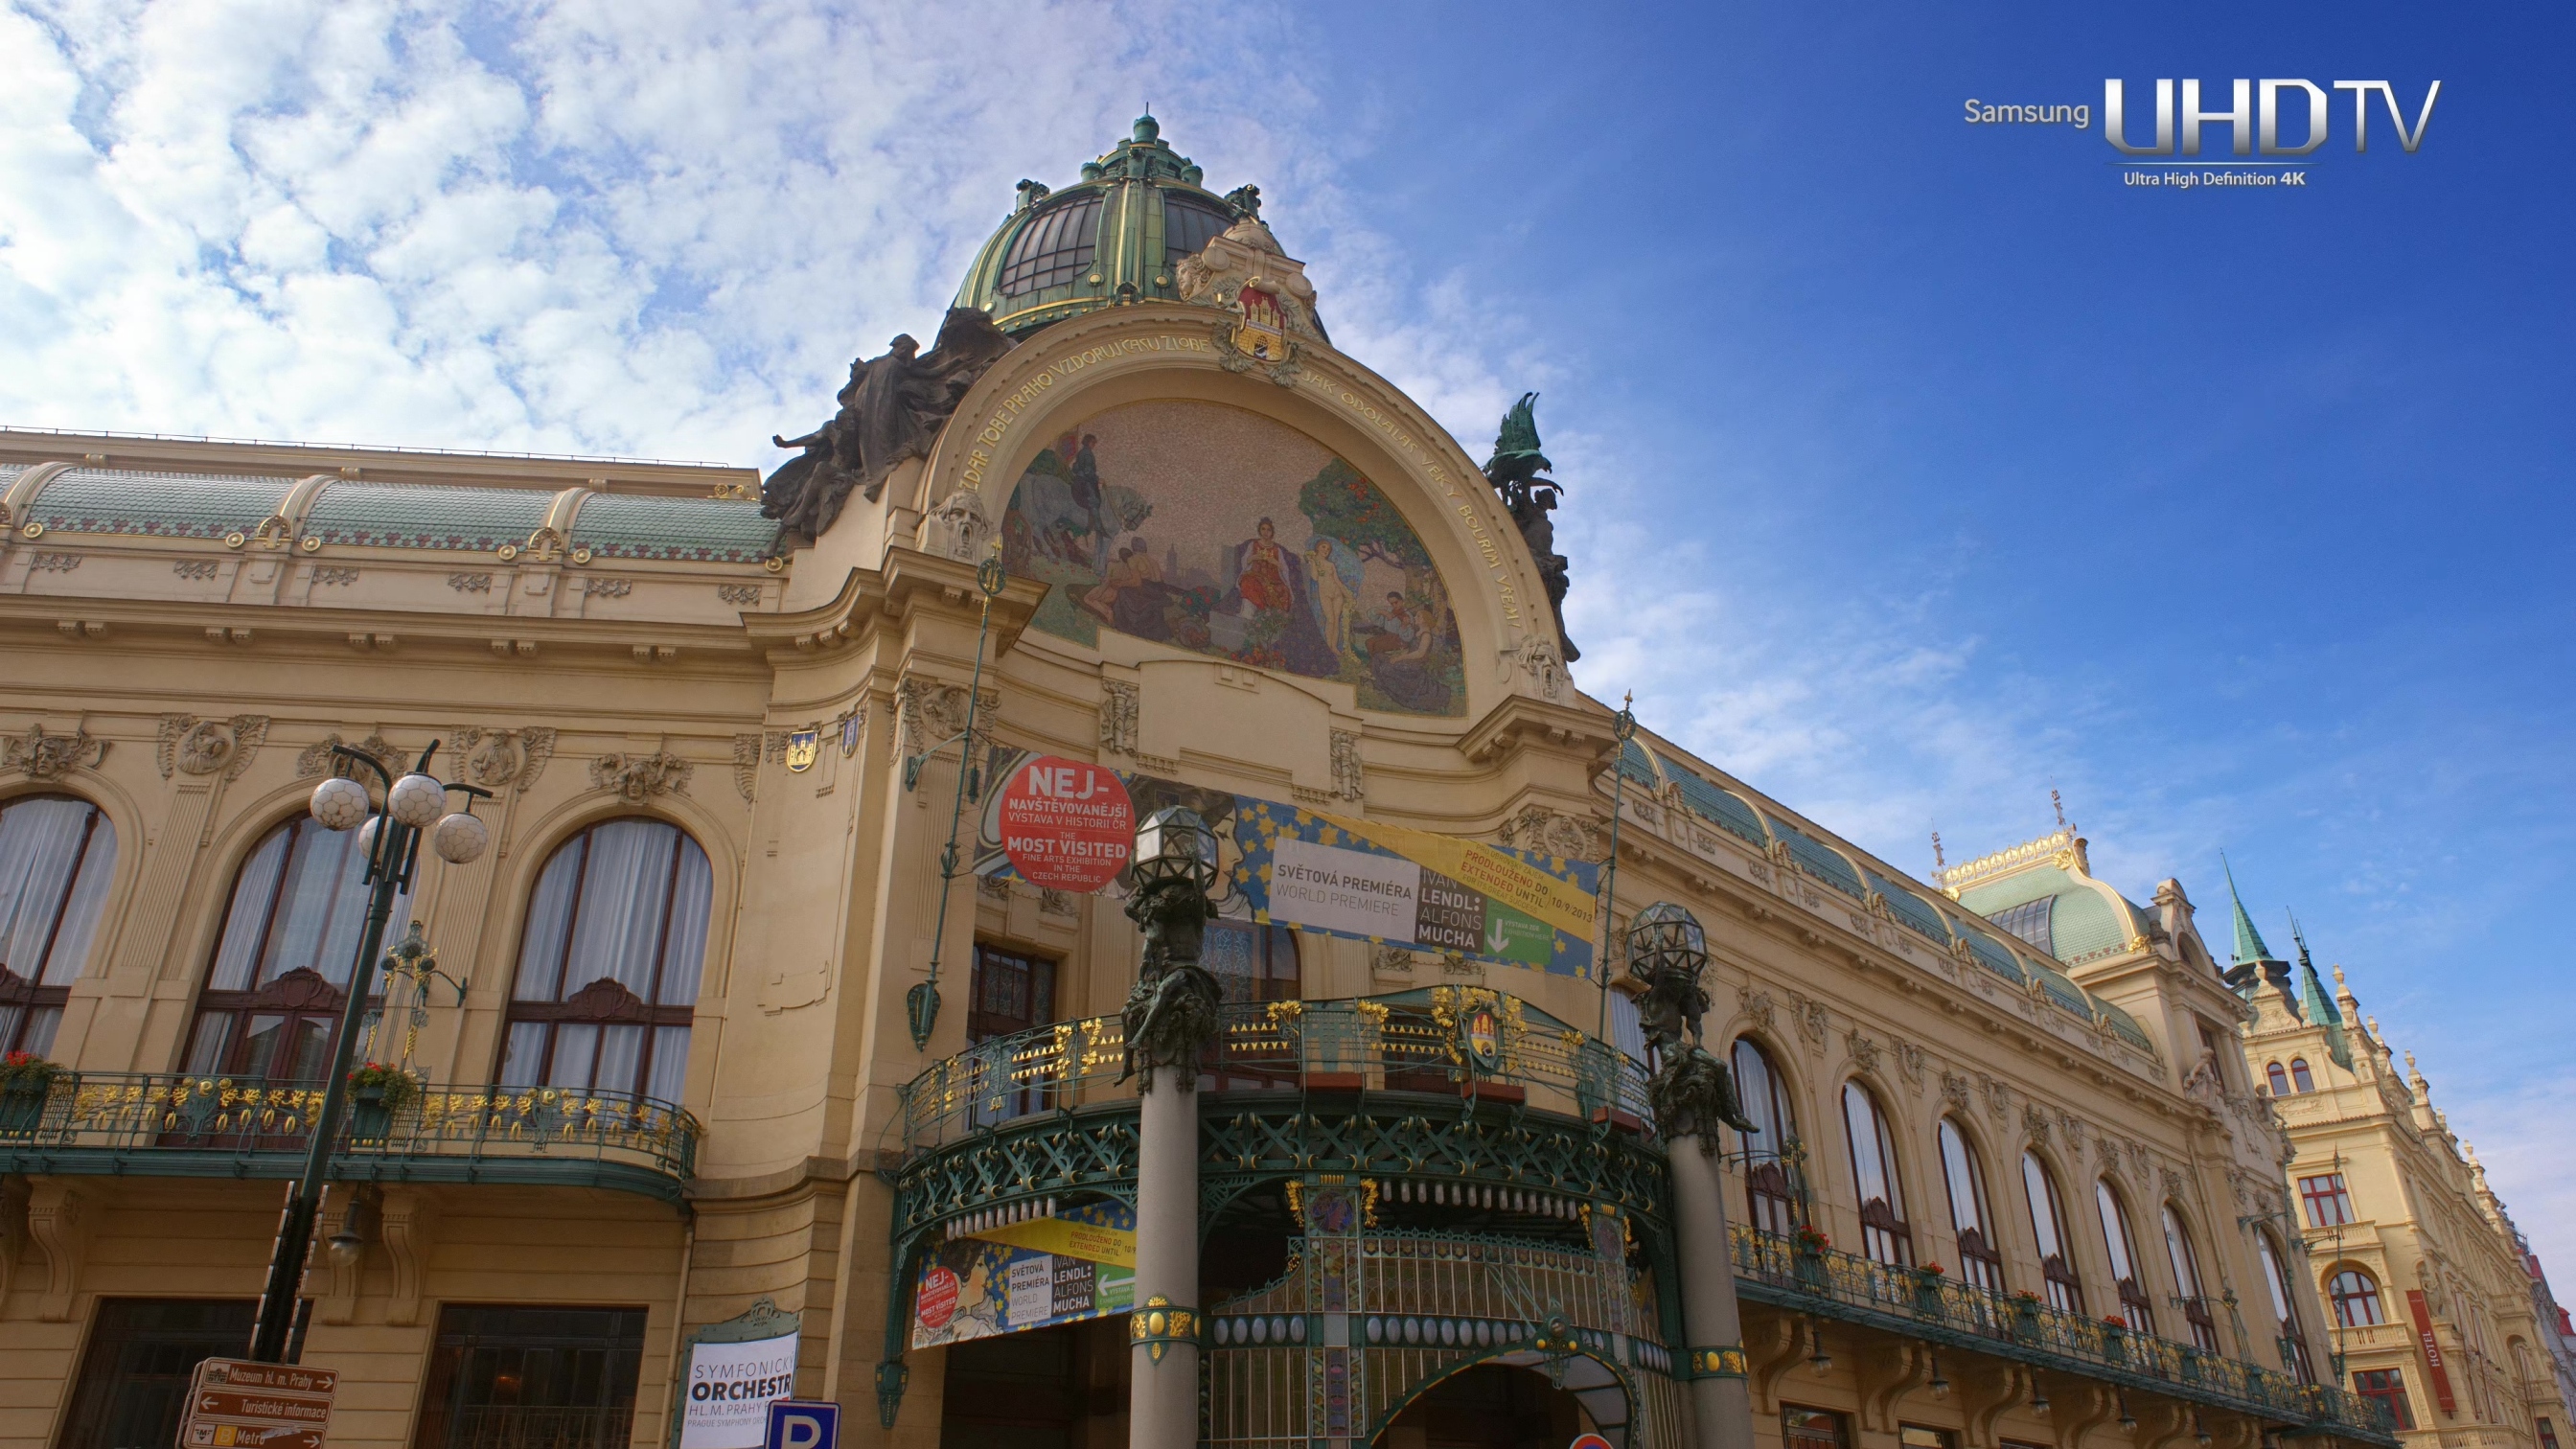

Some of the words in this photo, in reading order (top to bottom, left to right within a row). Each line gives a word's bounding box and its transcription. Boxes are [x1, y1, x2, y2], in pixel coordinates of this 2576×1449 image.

[1028, 766, 1109, 799] NEJ-
[1009, 797, 1127, 818] NAVŠTĚVOVANĚJŠÍ
[1008, 809, 1053, 824] VÝSTAVA
[1055, 816, 1064, 825] V
[1065, 816, 1110, 829] HISTORII
[1112, 817, 1126, 830] ČR
[1060, 831, 1076, 840] THE
[1008, 837, 1055, 854] MOST
[1059, 840, 1126, 859] VISITED
[1043, 855, 1065, 863] ARTS
[1066, 857, 1112, 866] EXHIBITION
[1032, 872, 1059, 881] CZECH
[1061, 873, 1101, 883] REPUBLIC
[1277, 863, 1339, 886] SVĚTOVÁ
[1342, 875, 1413, 900] PREMIÉRA
[1422, 869, 1458, 889] IVAN
[1464, 849, 1533, 888] PRODLOUŽENO
[1534, 882, 1549, 896] DO
[1460, 862, 1514, 893] EXTENDED
[1515, 886, 1544, 908] UNTIL
[1462, 874, 1476, 886] FOR
[1476, 879, 1488, 890] ITS
[1487, 886, 1509, 901] GREAT
[1508, 895, 1538, 914] SUCCESS
[1276, 882, 1326, 904] WORLD
[1330, 892, 1400, 917] PREMIERE
[1551, 896, 1593, 924] 10/9/2013
[1420, 907, 1482, 931] ALFONS
[1418, 925, 1476, 949] MUCHA
[1070, 1240, 1100, 1253] EXTENDED
[1101, 1246, 1119, 1256] UNTIL
[1011, 1261, 1044, 1278] SVĚTOVÁ
[1054, 1256, 1076, 1269] IVAN
[925, 1271, 949, 1292] NEJ-
[1012, 1276, 1049, 1292] PREMIÉRA
[1054, 1279, 1093, 1299] ALFONS
[1011, 1294, 1038, 1306] WORLD
[1053, 1296, 1090, 1313] MUCHA
[921, 1305, 935, 1317] MOST
[1011, 1306, 1048, 1322] PREMIERE
[2423, 1330, 2440, 1368] HOTEL
[694, 1350, 794, 1379] SYMFONICKÝ
[229, 1368, 264, 1384] Muzeum
[264, 1370, 274, 1385] hl.
[277, 1375, 287, 1386] m.
[289, 1374, 313, 1391] Prahy
[692, 1373, 792, 1402] ORCHESTR
[242, 1398, 284, 1416] Turistické
[284, 1402, 327, 1419] informace
[726, 1401, 763, 1415] PRAHY
[687, 1416, 716, 1428] PRAGUE
[717, 1416, 752, 1427] SYMPHONY
[781, 1414, 821, 1449] P
[219, 1428, 233, 1443] B
[236, 1430, 265, 1445] Metro
